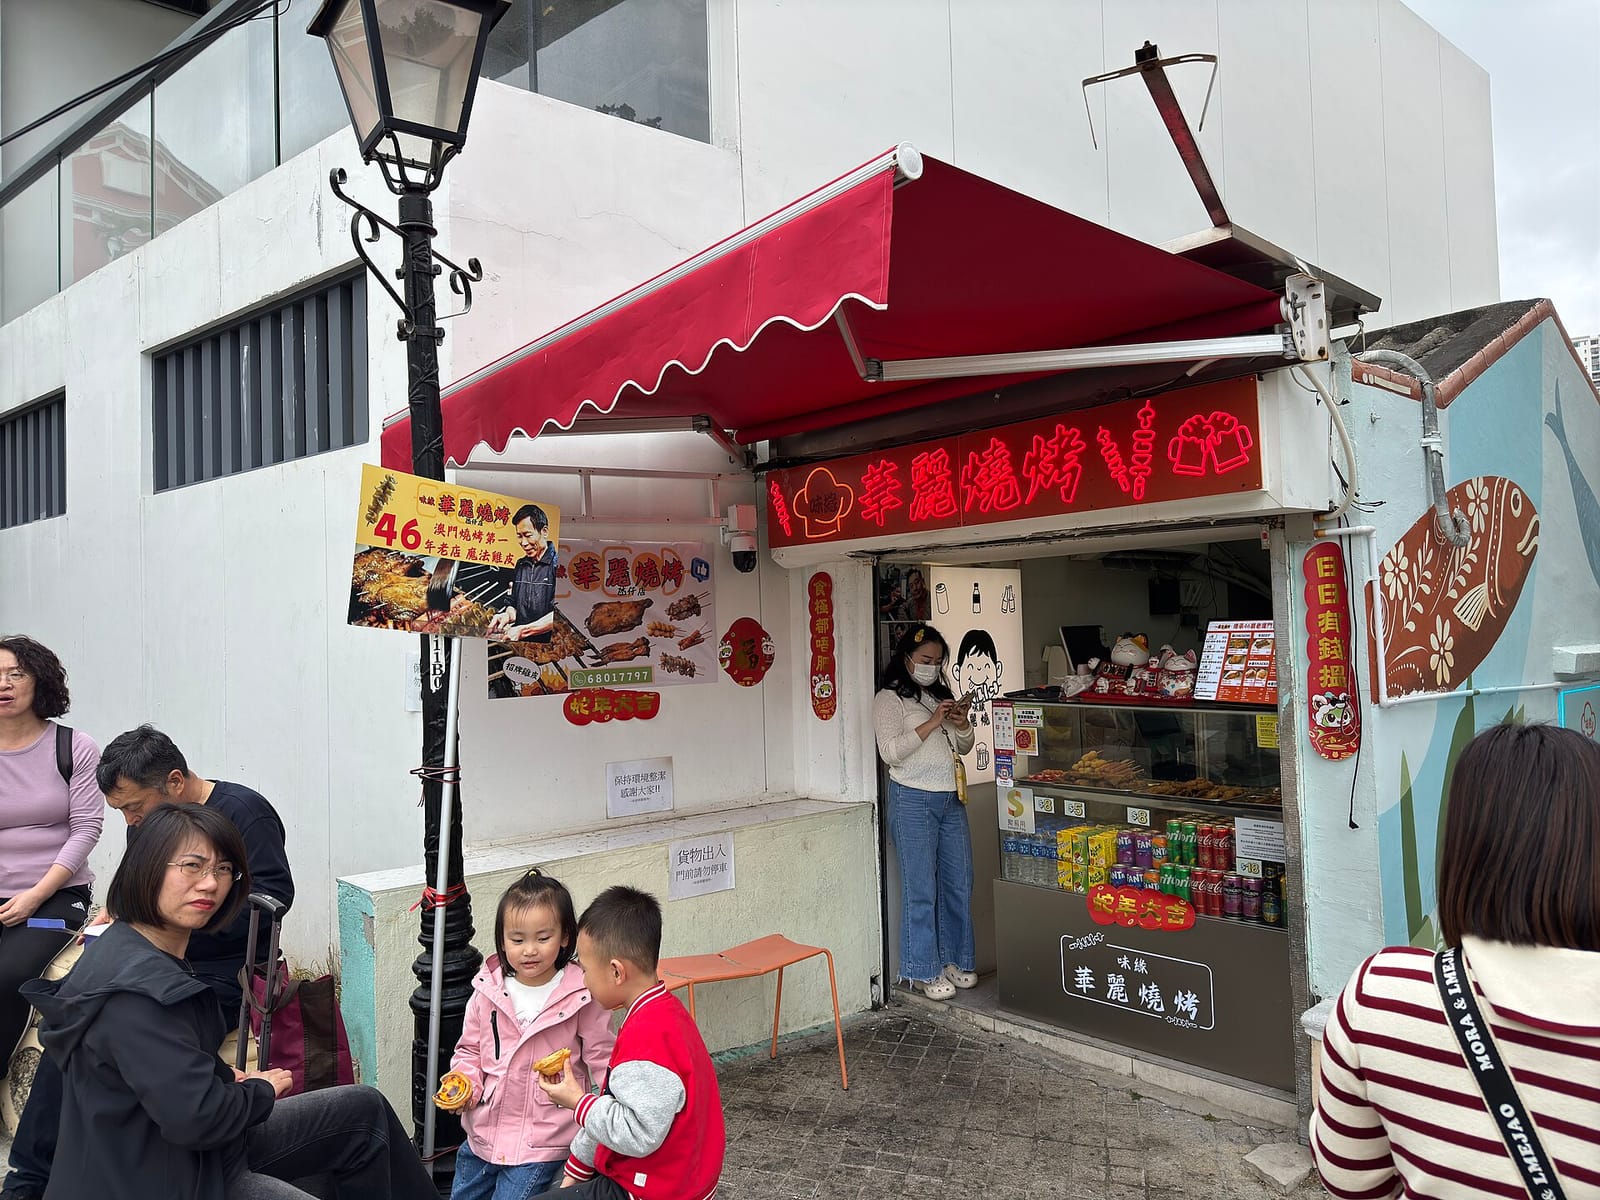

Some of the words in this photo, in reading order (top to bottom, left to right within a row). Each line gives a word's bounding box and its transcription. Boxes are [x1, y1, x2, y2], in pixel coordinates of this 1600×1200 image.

[858, 418, 1086, 528] 華麗燒烤
[437, 494, 511, 527] 華麗燒烤
[374, 512, 422, 550] 46
[433, 522, 508, 545] 澳門燒烤第一
[424, 539, 462, 557] 年老店
[465, 547, 515, 567] 魔法雞皮
[573, 556, 685, 590] 華麗燒烤
[1316, 555, 1347, 688] 日日有錢搵
[587, 671, 648, 684] 68017797
[570, 694, 655, 715] 蛇年大吉
[614, 770, 666, 786] 保持環境整潔
[1131, 810, 1147, 824] $8
[677, 843, 726, 867] 貨物出入
[675, 862, 728, 882] 門前請勿停車
[1093, 891, 1188, 925] 蛇年大吉
[1116, 954, 1149, 975] 味緣
[1073, 965, 1201, 1020] 華麗燒烤
[1453, 997, 1468, 1010] &
[1459, 1013, 1494, 1072] MORA
[1499, 1103, 1549, 1186] LMEJAO
